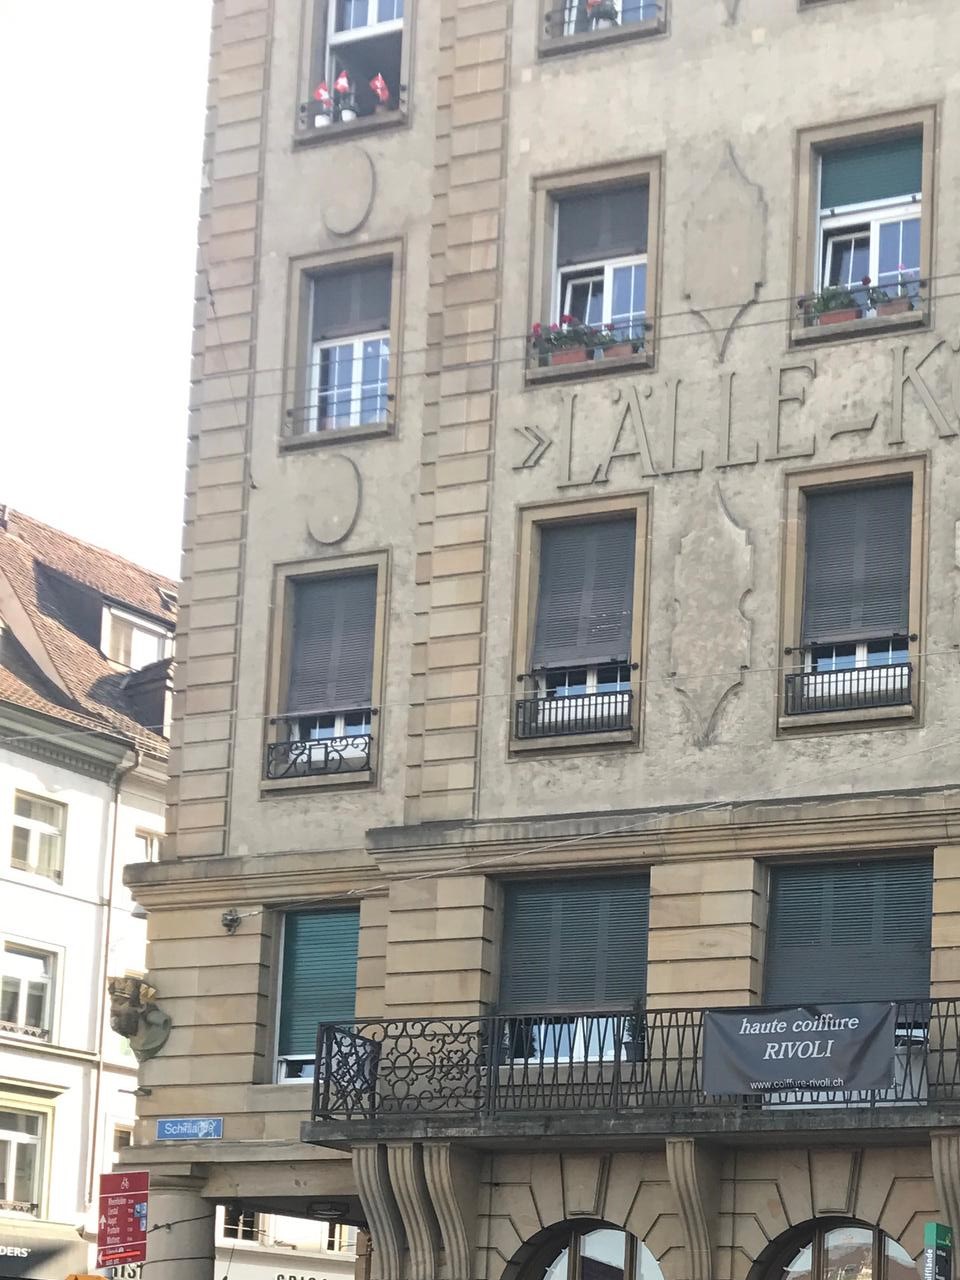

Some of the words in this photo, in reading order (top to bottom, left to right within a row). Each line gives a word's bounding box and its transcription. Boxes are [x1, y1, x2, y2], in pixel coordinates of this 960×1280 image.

[739, 1018, 787, 1035] haute
[792, 1014, 860, 1032] coiffure
[763, 1040, 834, 1060] RIVOLI
[750, 1078, 844, 1089] www.coiffure-rivoli.ch
